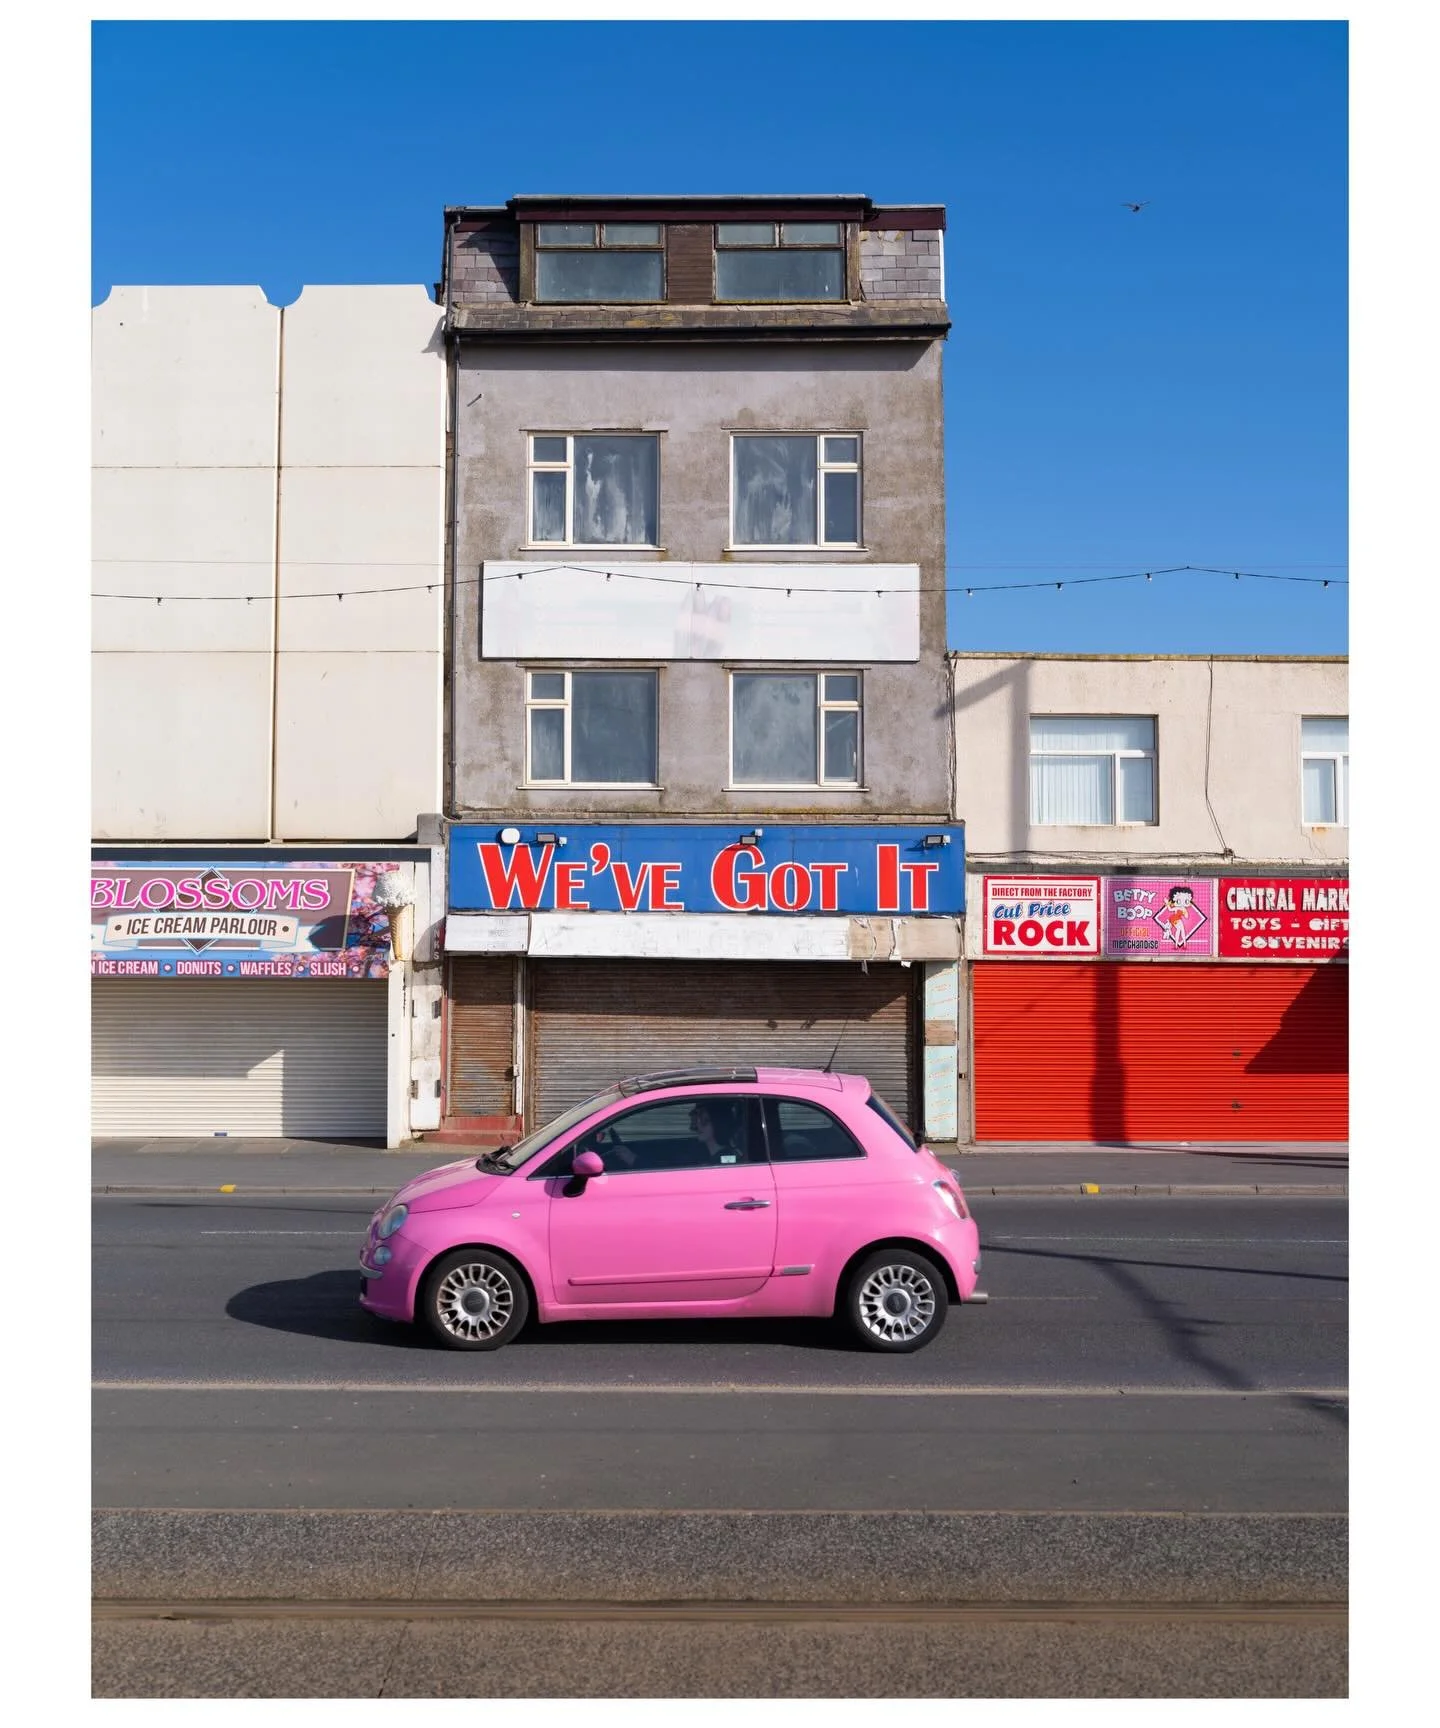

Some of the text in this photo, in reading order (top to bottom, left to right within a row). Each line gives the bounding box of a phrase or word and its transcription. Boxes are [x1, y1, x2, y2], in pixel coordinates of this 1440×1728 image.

[477, 841, 940, 912] WE'VE GOT IT
[91, 877, 331, 909] BLOSSOMS
[992, 887, 1093, 897] DIRECT FROM THE FACTORY
[1113, 888, 1157, 903] BETTY
[1226, 887, 1296, 911] CENTRAL
[993, 901, 1071, 919] Cut Price
[1117, 905, 1153, 921] BOOP
[126, 917, 277, 936] ICE CREAM PARLOUR
[1230, 917, 1282, 930] TOYS
[993, 919, 1091, 947] ROCK
[98, 960, 117, 974] ICE
[117, 960, 159, 975] CREAM
[177, 961, 222, 975] DONUTS
[239, 962, 292, 976] WAFFLES
[310, 962, 347, 976] SLUSH
